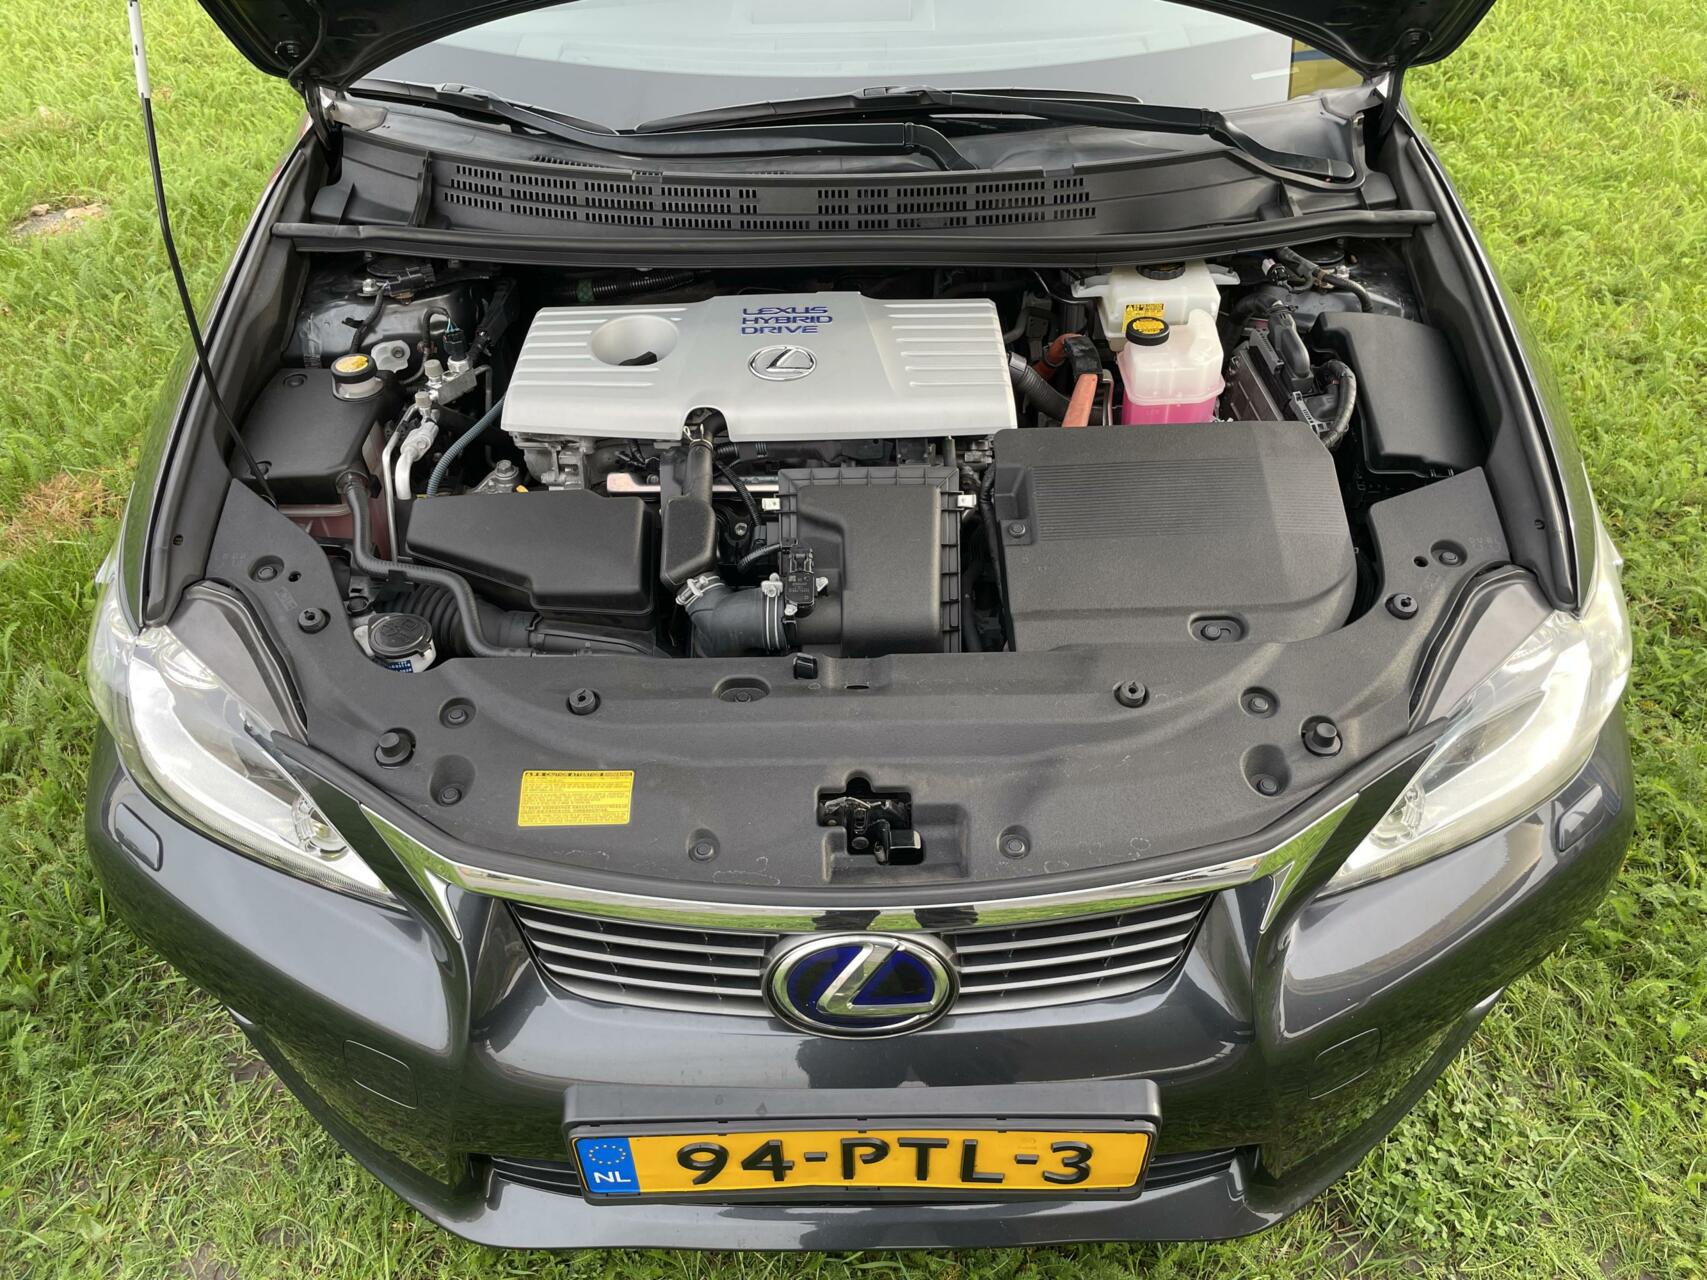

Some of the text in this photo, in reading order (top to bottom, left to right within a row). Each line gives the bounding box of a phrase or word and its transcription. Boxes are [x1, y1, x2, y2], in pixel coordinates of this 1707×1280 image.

[743, 306, 828, 316] LEXUS
[742, 315, 833, 325] HYBRID
[741, 325, 819, 335] DRIVE
[677, 1137, 1094, 1185] 94-PTL-3
[593, 1171, 632, 1184] NL
